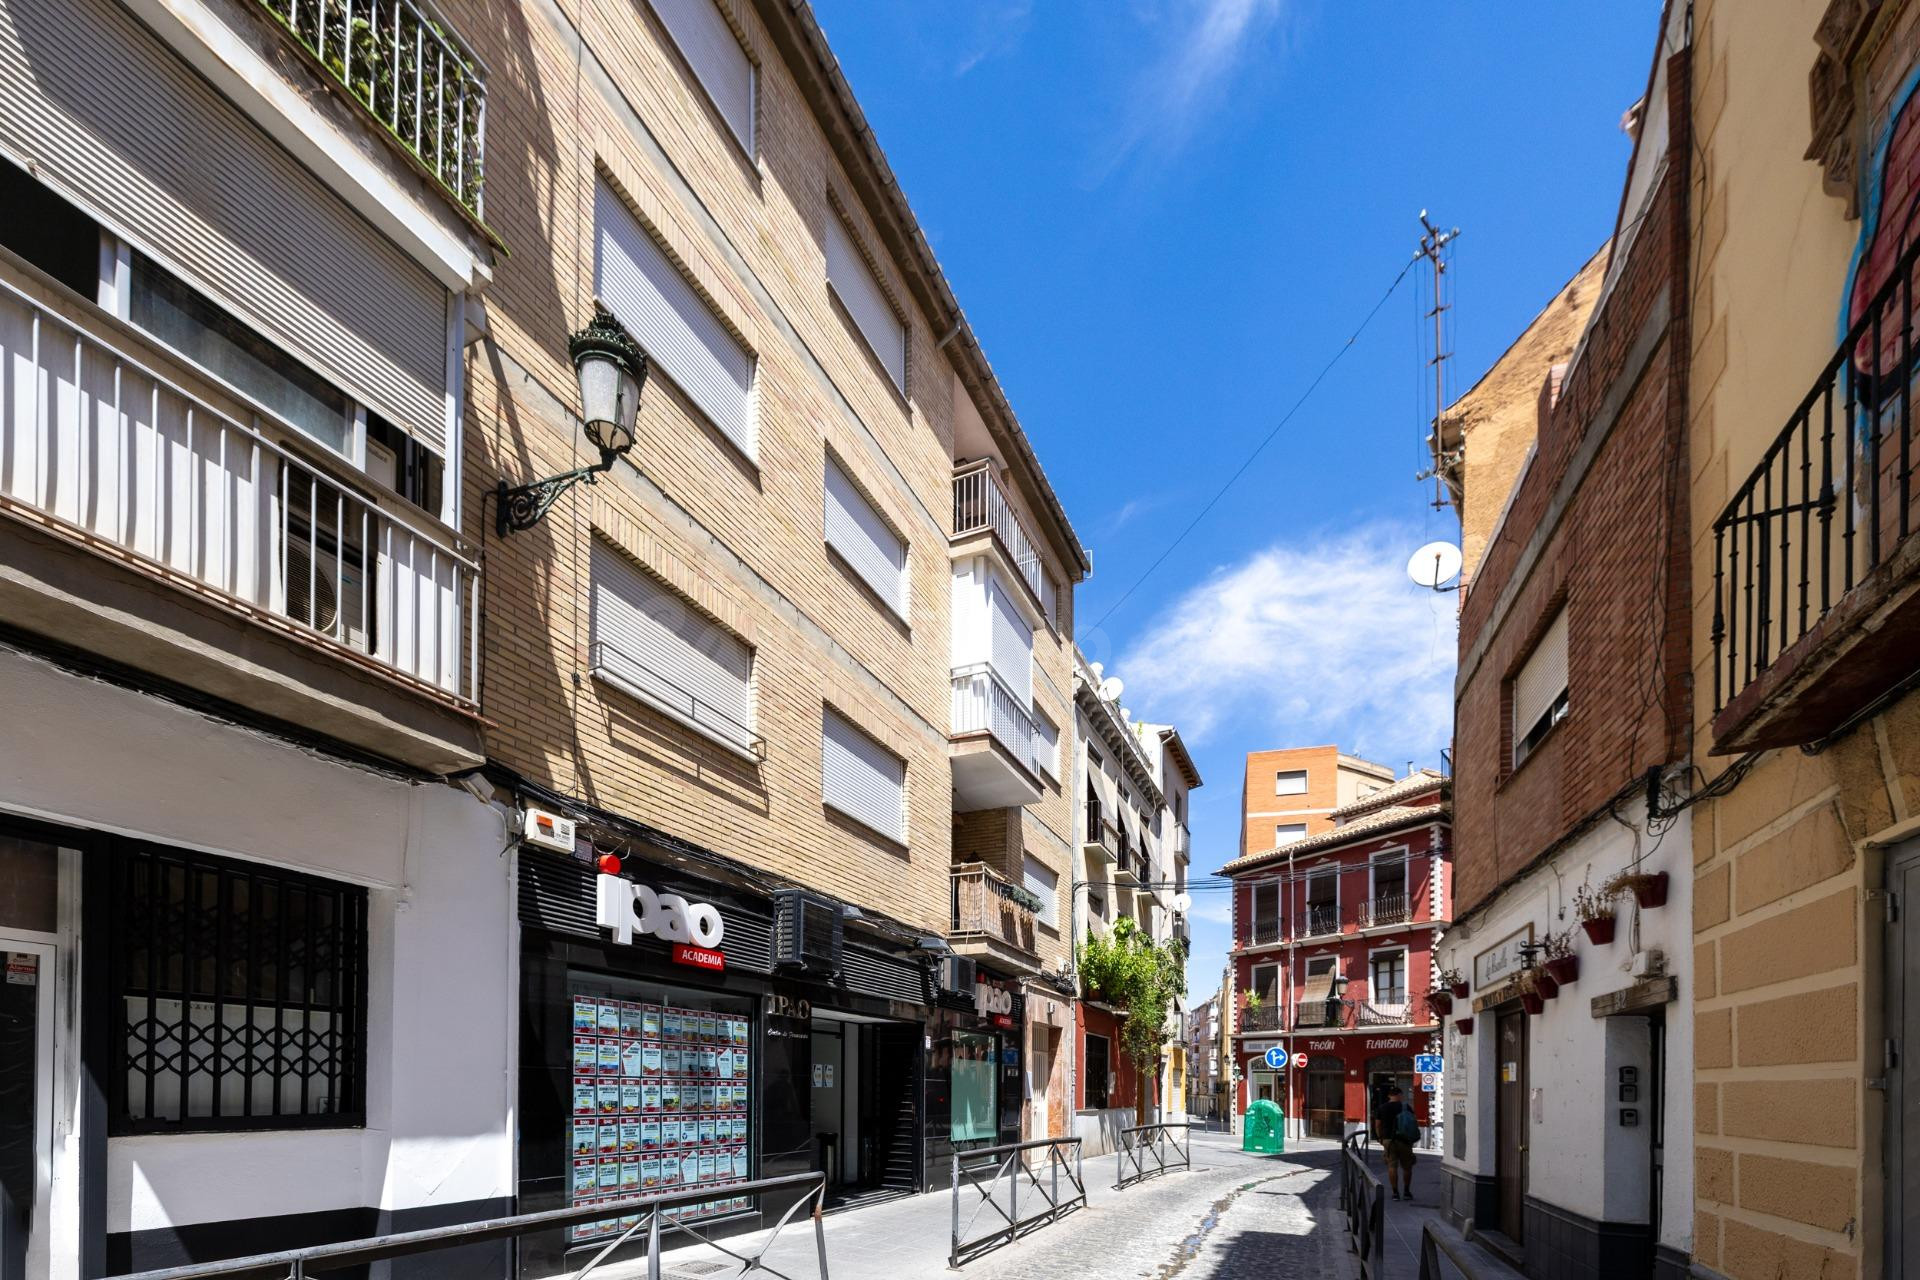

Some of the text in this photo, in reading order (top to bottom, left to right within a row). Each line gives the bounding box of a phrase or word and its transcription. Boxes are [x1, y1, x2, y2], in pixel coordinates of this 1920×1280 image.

[597, 854, 724, 948] ipao
[682, 950, 722, 966] ACADEMIA
[766, 993, 810, 1020] IPAO
[1309, 1039, 1408, 1050] TACÓN FLAMENCO
